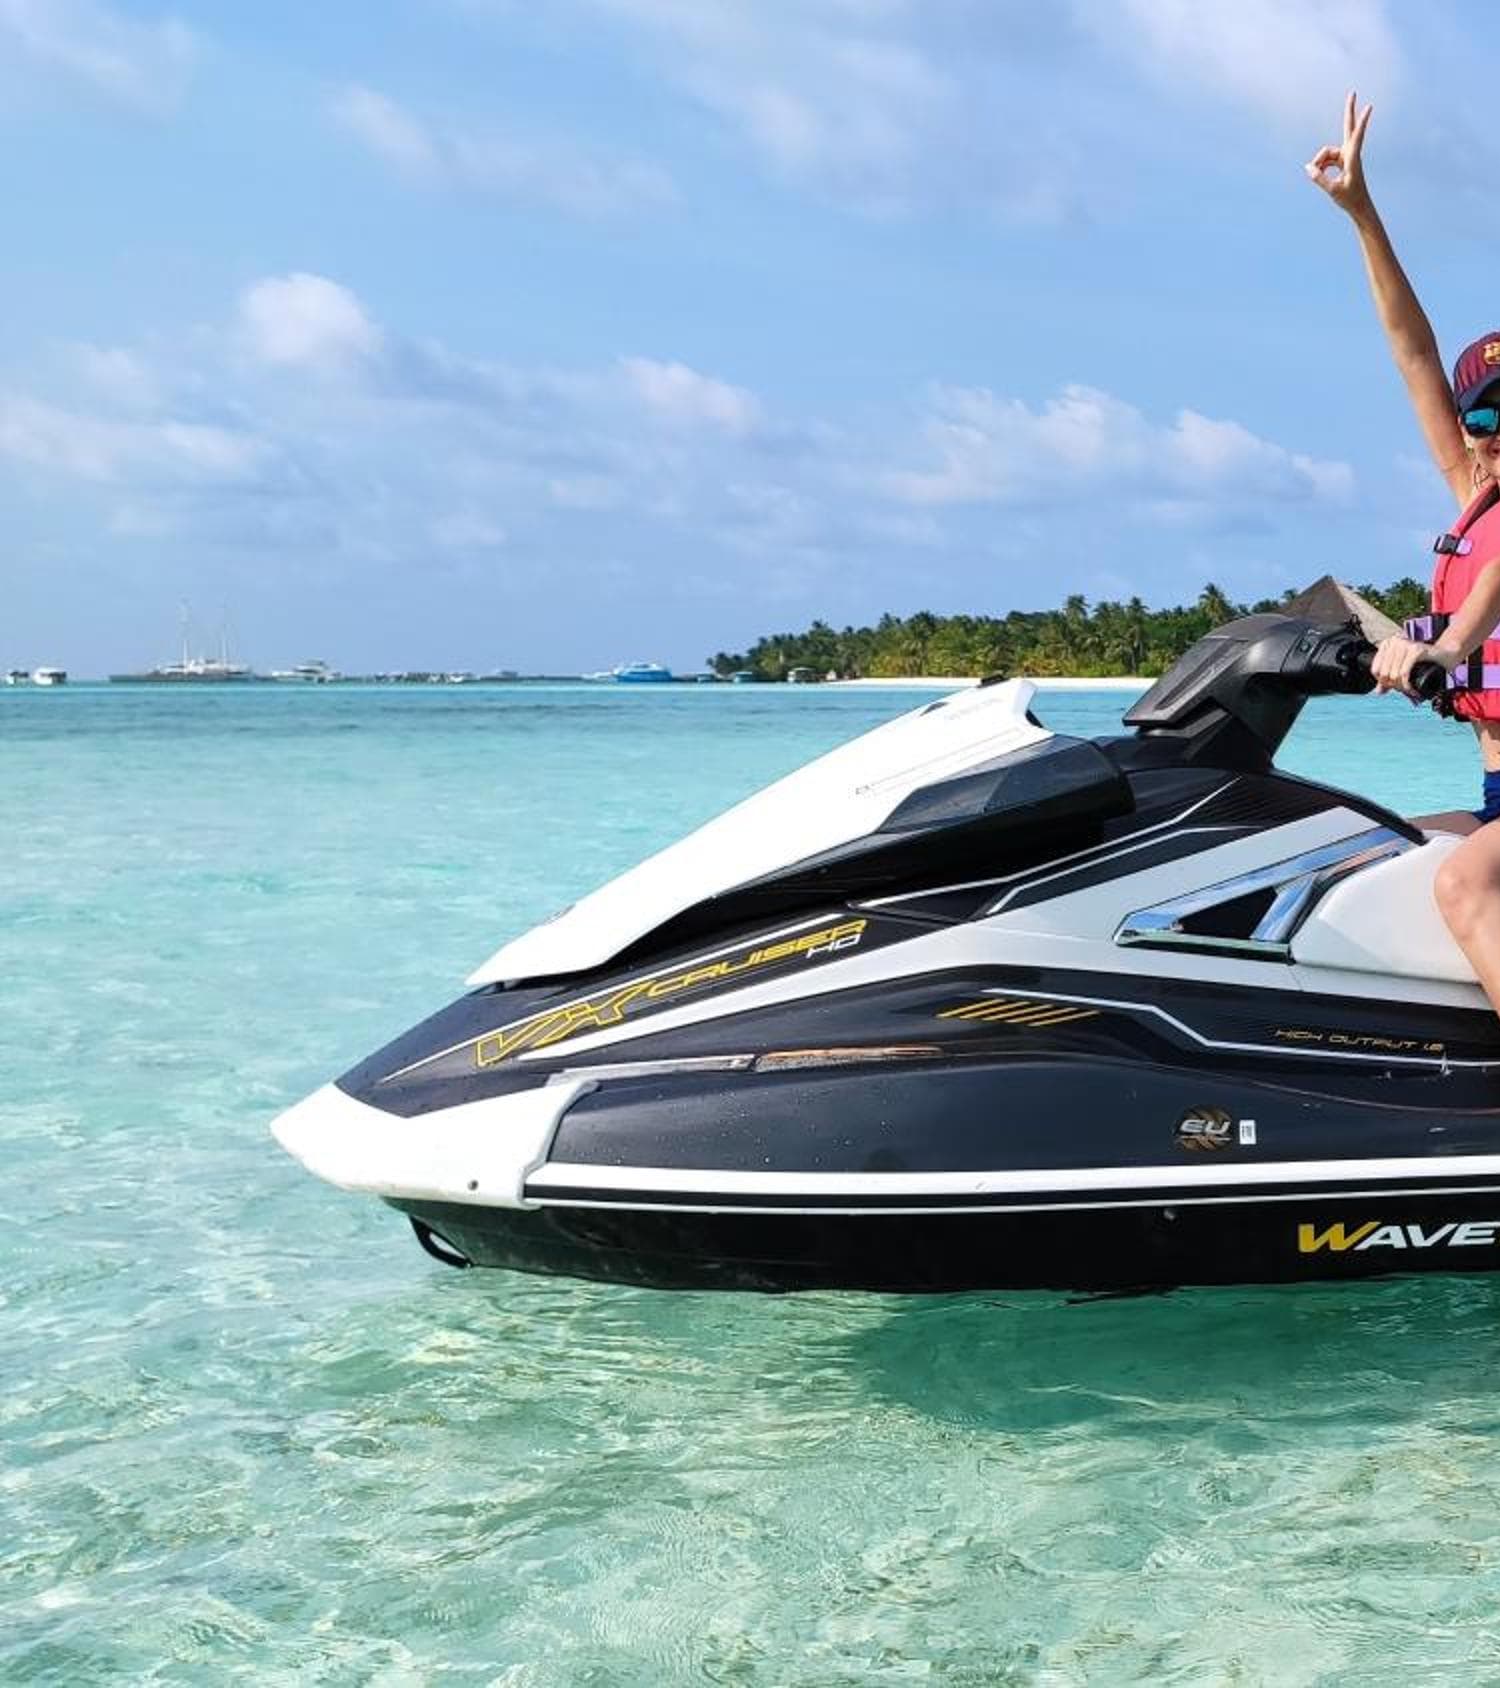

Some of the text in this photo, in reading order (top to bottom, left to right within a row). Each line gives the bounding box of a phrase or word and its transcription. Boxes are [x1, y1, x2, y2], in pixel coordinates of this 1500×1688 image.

[475, 918, 868, 1067] VX CRUISER
[1329, 1035, 1417, 1049] OUTPUT
